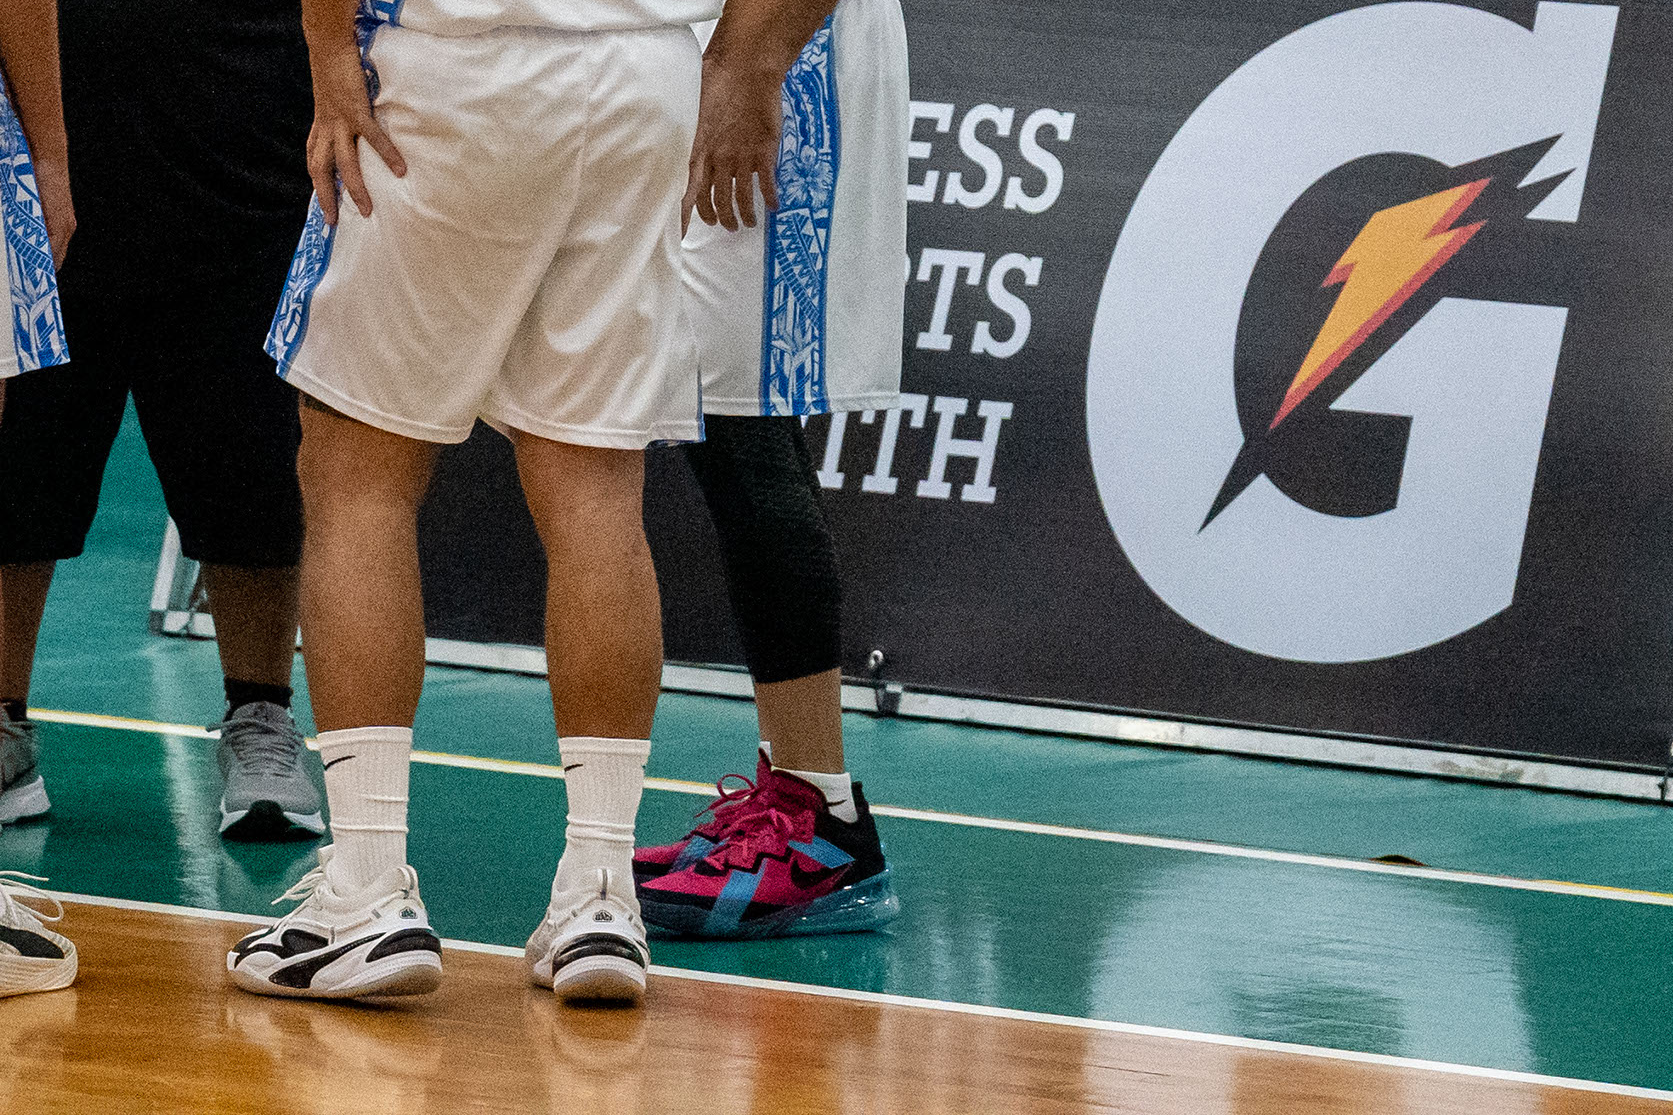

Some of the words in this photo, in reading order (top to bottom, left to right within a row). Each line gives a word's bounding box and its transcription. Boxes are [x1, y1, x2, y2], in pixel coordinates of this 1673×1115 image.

[904, 248, 1044, 359] TS
[1086, 1, 1619, 664] G
[802, 392, 1014, 504] ITH
